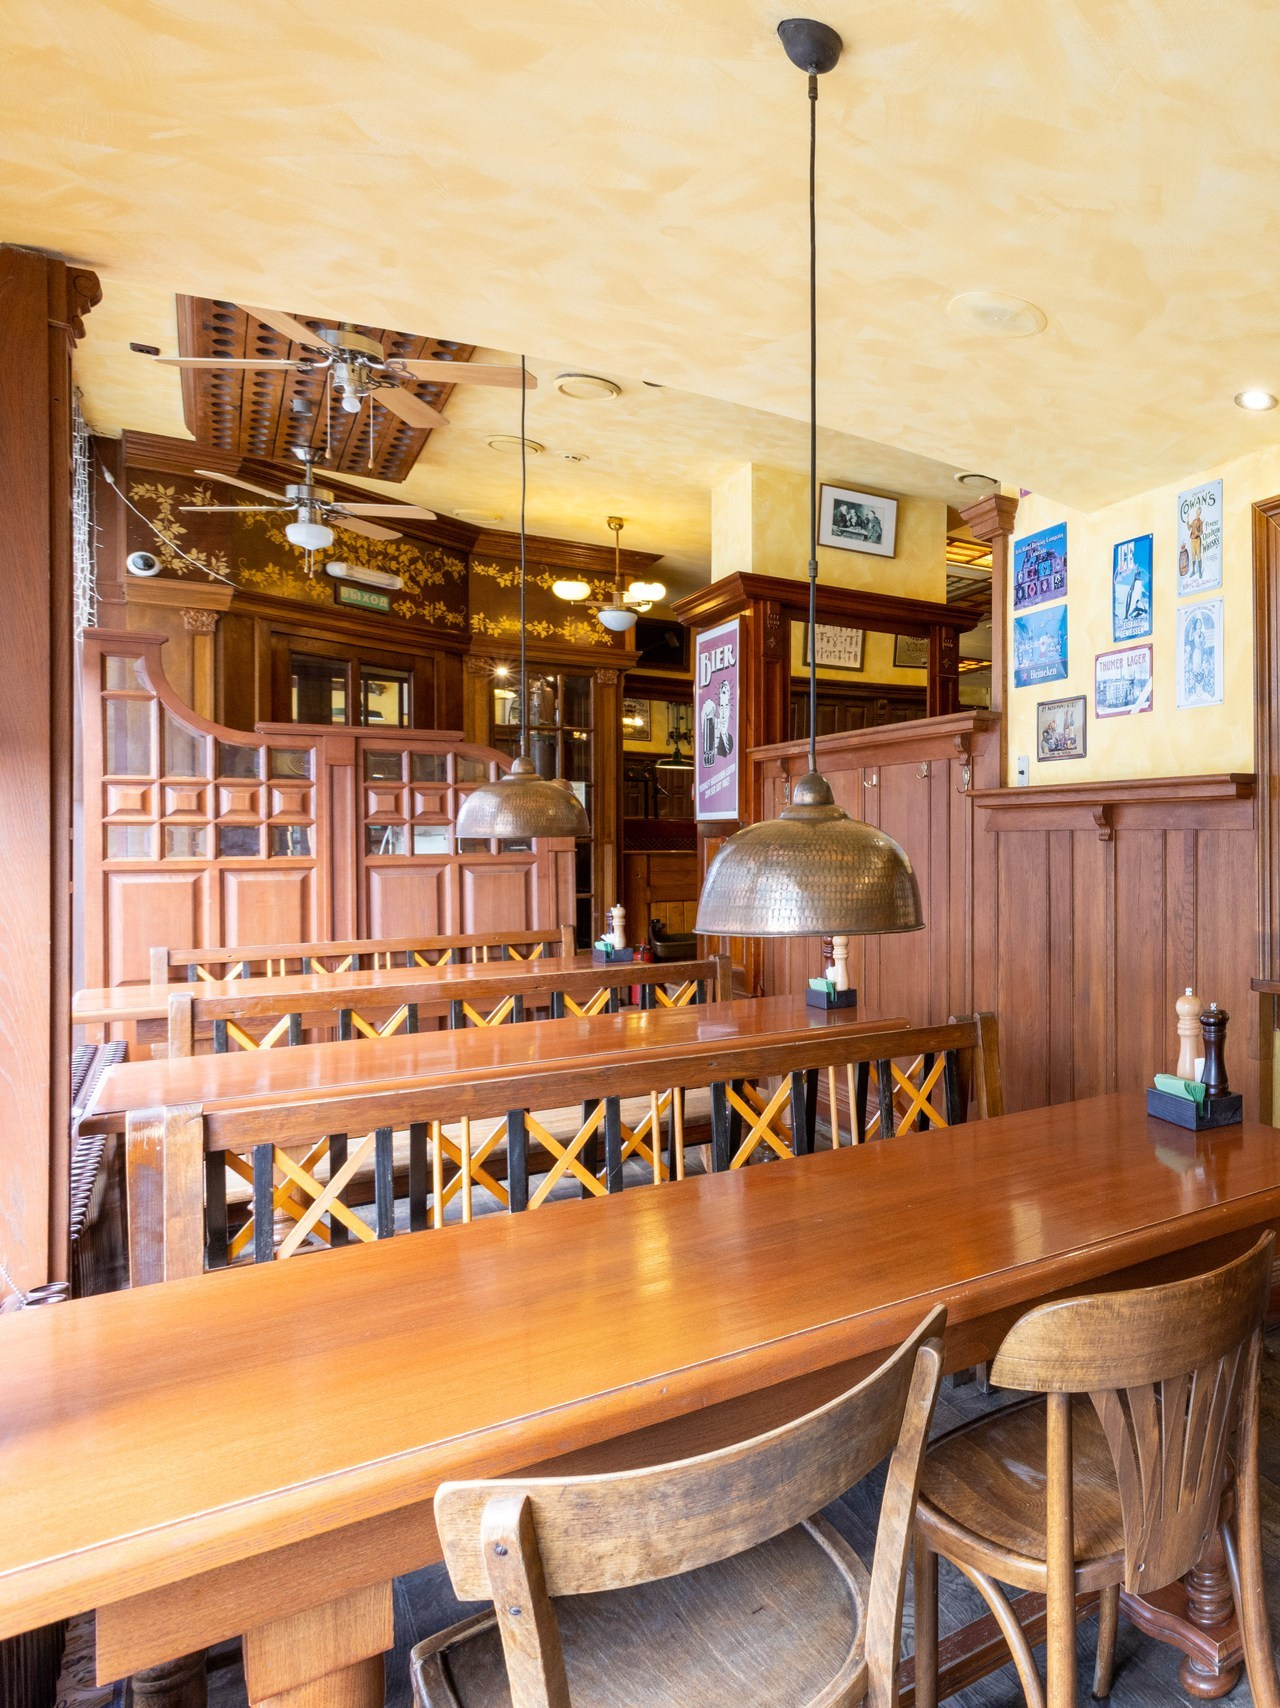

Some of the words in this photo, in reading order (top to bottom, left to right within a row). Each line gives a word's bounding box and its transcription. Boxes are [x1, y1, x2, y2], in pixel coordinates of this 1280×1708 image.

[1180, 490, 1216, 523] COWAN'S
[341, 588, 388, 607] ВЫХОД
[700, 643, 737, 688] BIER
[1126, 653, 1147, 667] LAGER
[1030, 666, 1057, 680] Heineken
